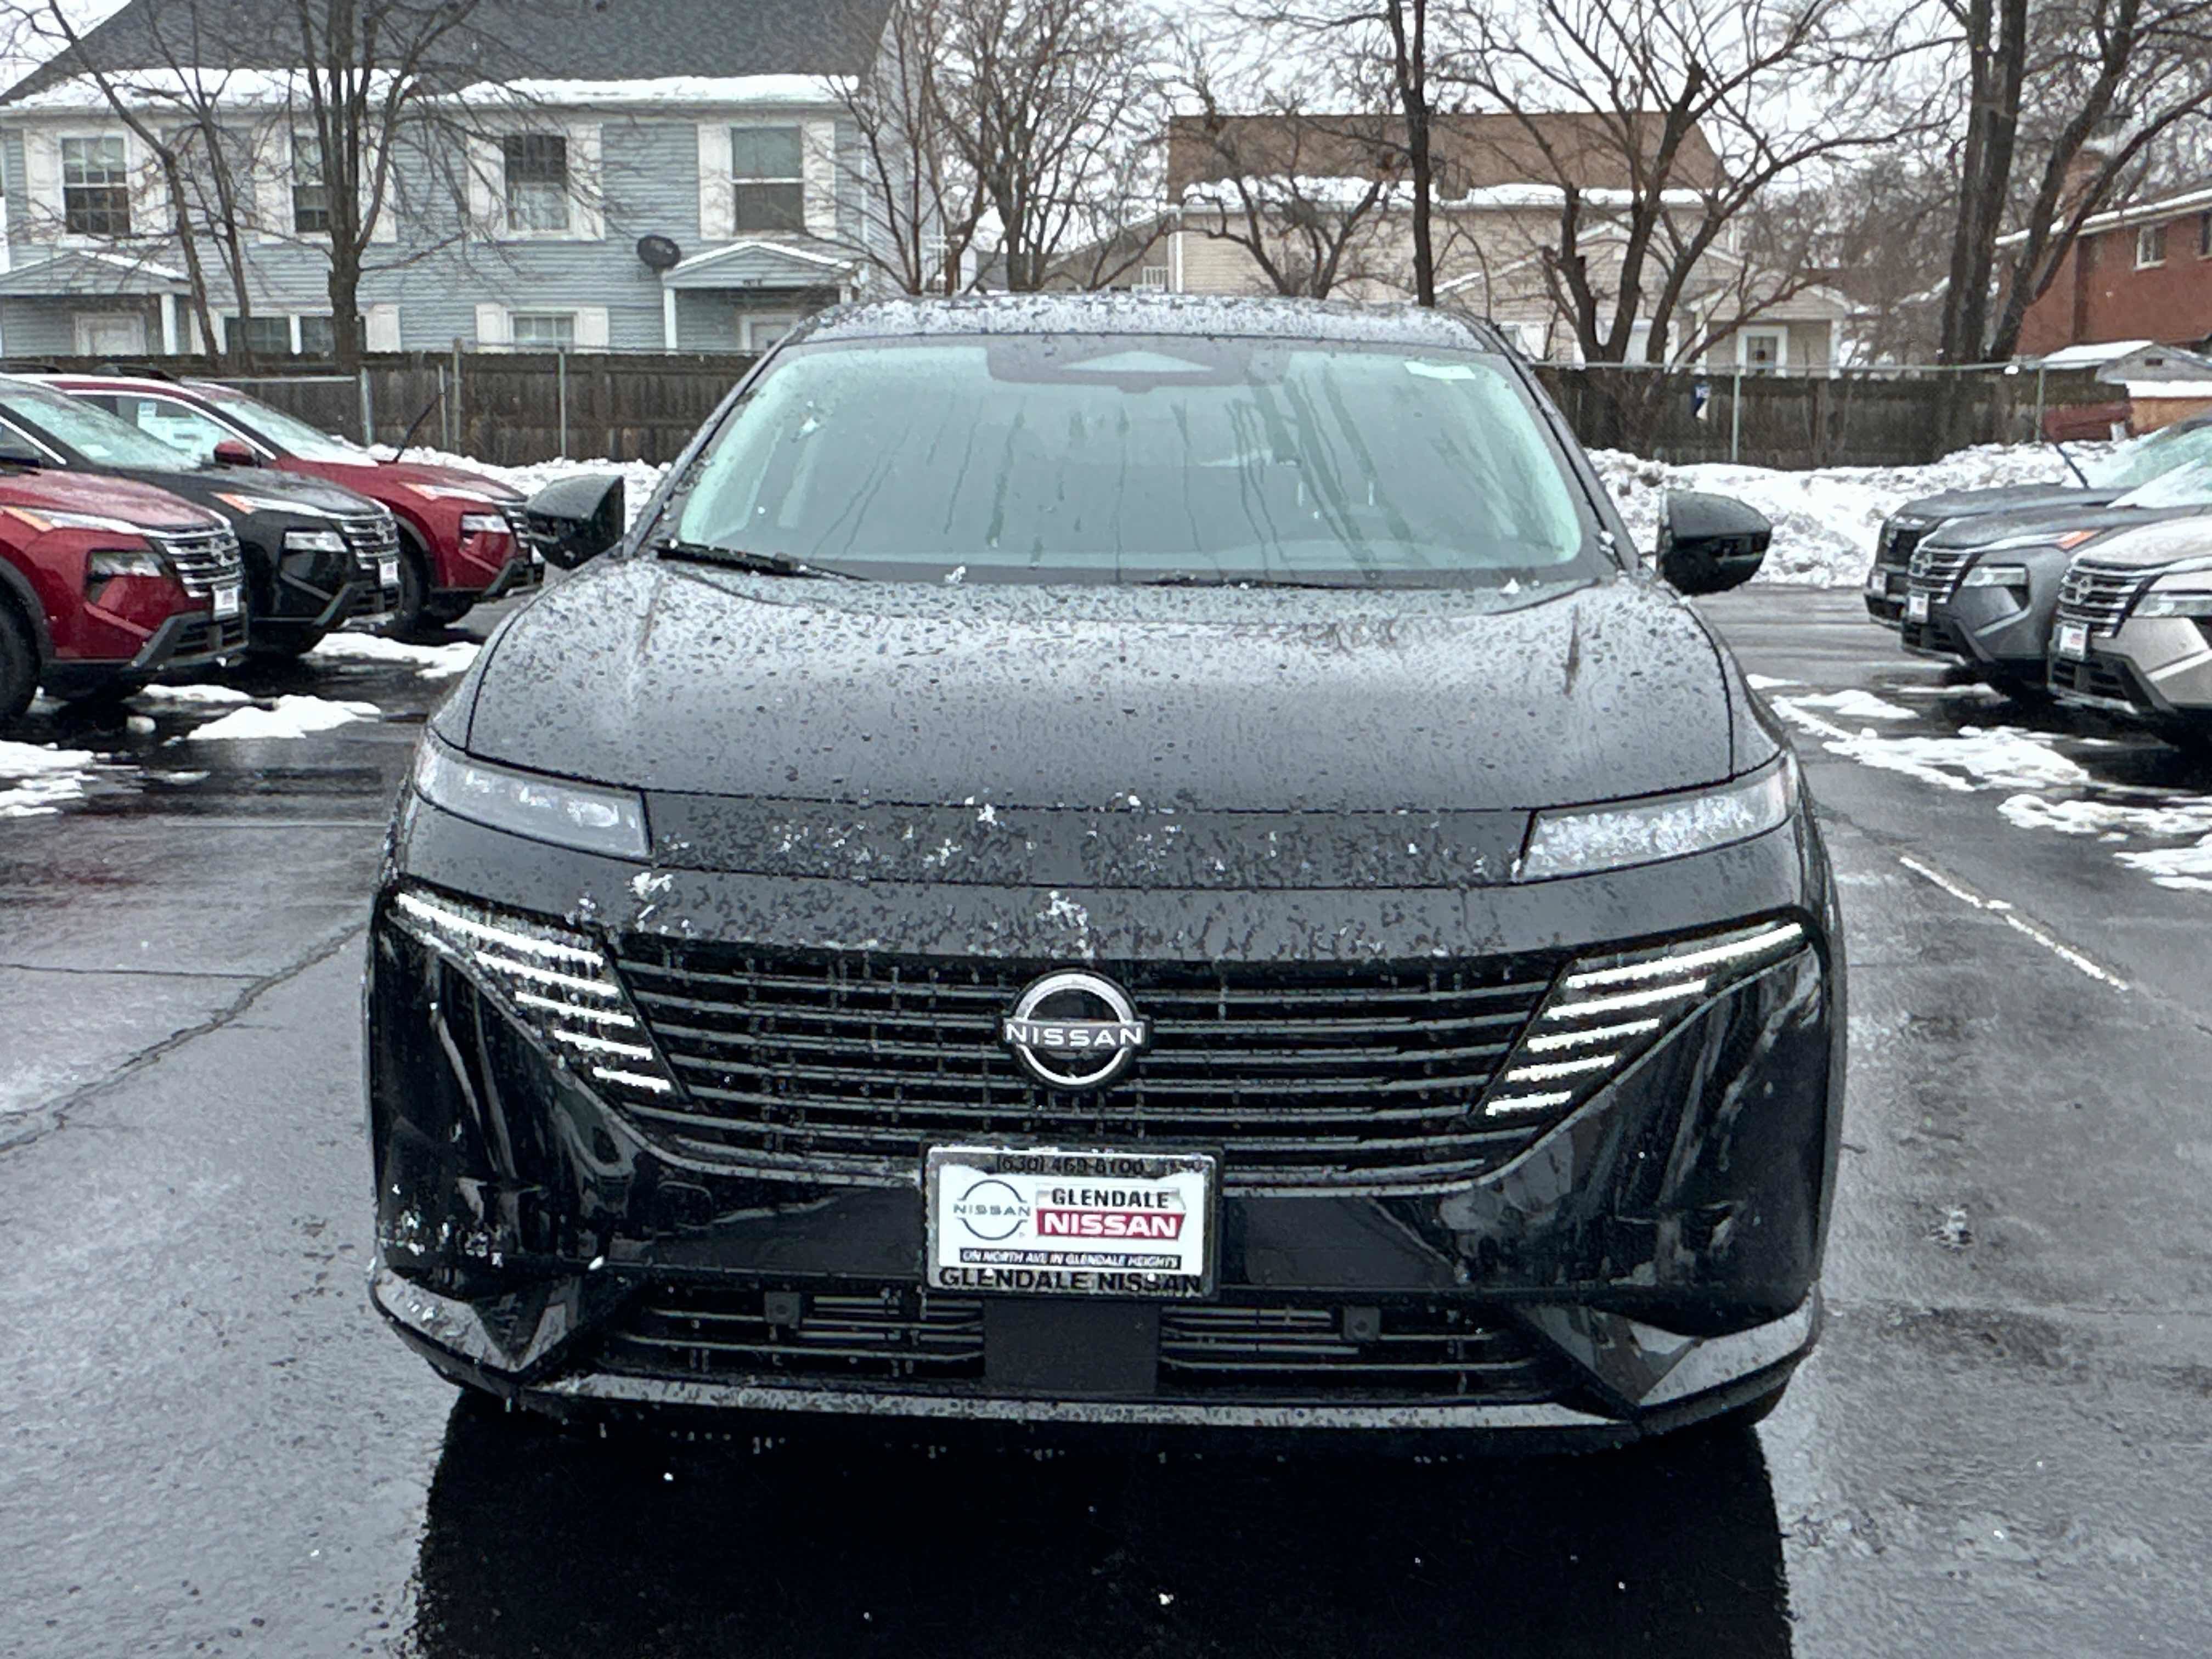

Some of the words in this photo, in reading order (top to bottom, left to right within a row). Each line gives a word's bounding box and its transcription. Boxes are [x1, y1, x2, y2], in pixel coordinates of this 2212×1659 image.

[1006, 1023, 1142, 1046] NISSAN
[1052, 1187, 1170, 1209] GLENDALE
[953, 1204, 1031, 1217] NISSAN
[1044, 1212, 1177, 1237] NISSAN
[939, 1267, 1091, 1290] GLENDALE
[1099, 1271, 1201, 1294] NISSAN
